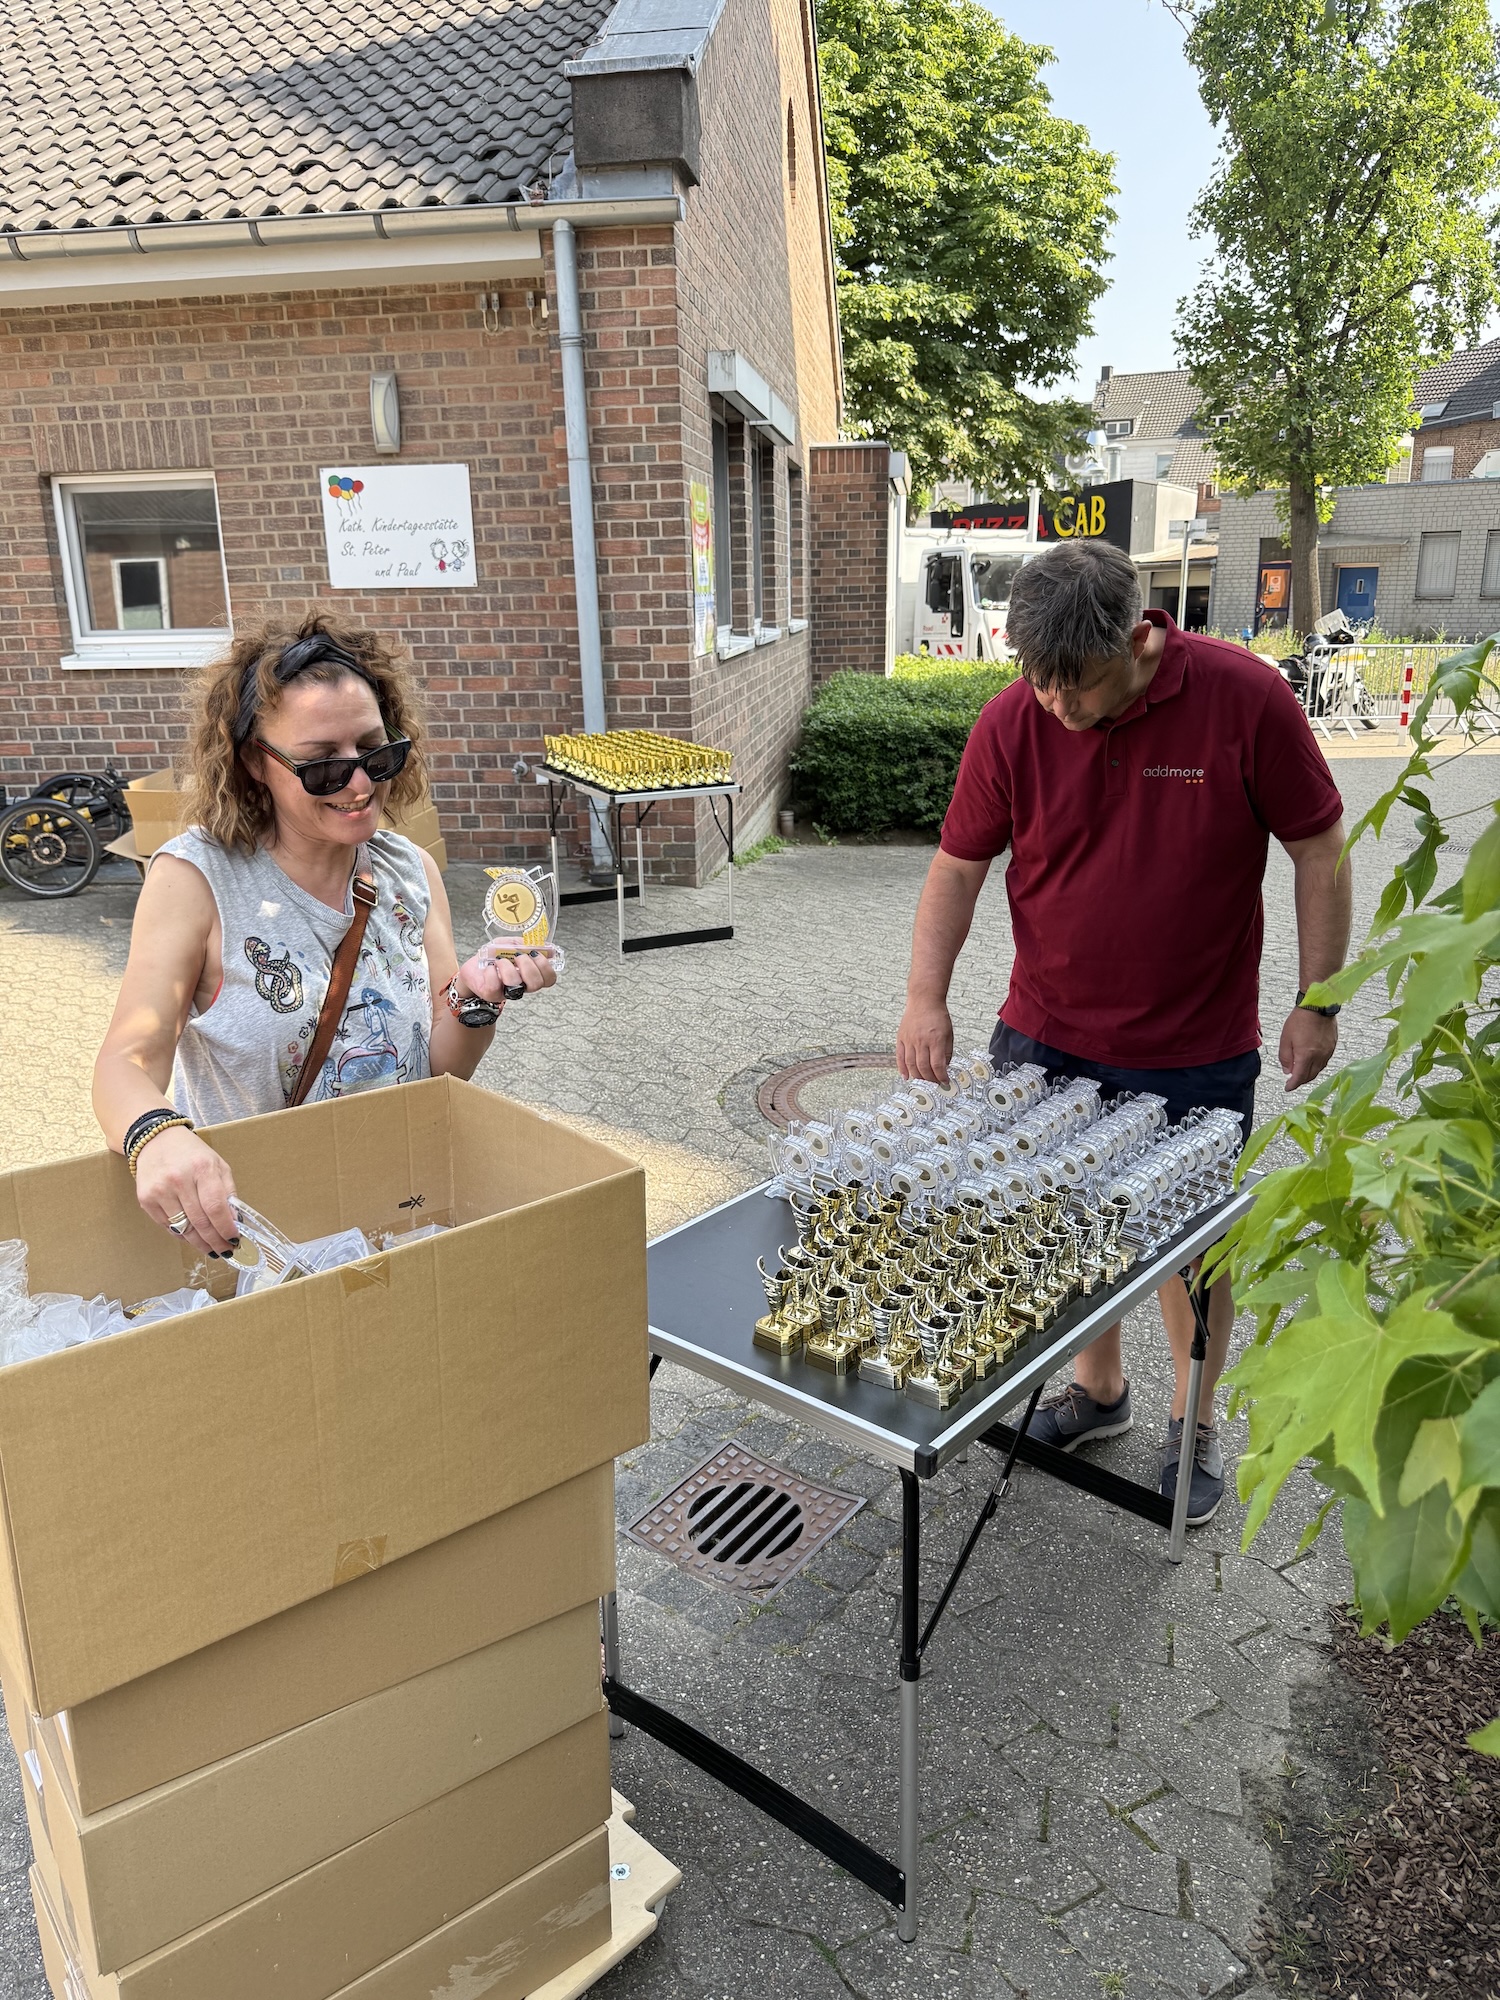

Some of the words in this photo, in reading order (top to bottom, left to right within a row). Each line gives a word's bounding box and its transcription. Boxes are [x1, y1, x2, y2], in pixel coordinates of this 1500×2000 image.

[1053, 495, 1106, 537] CAB
[338, 518, 365, 533] Kath.
[371, 517, 459, 536] Kindertagesstätte
[341, 541, 357, 557] St.
[362, 541, 391, 557] Peter
[374, 563, 392, 577] und
[396, 562, 422, 577] Paul
[1142, 764, 1205, 778] addmore
